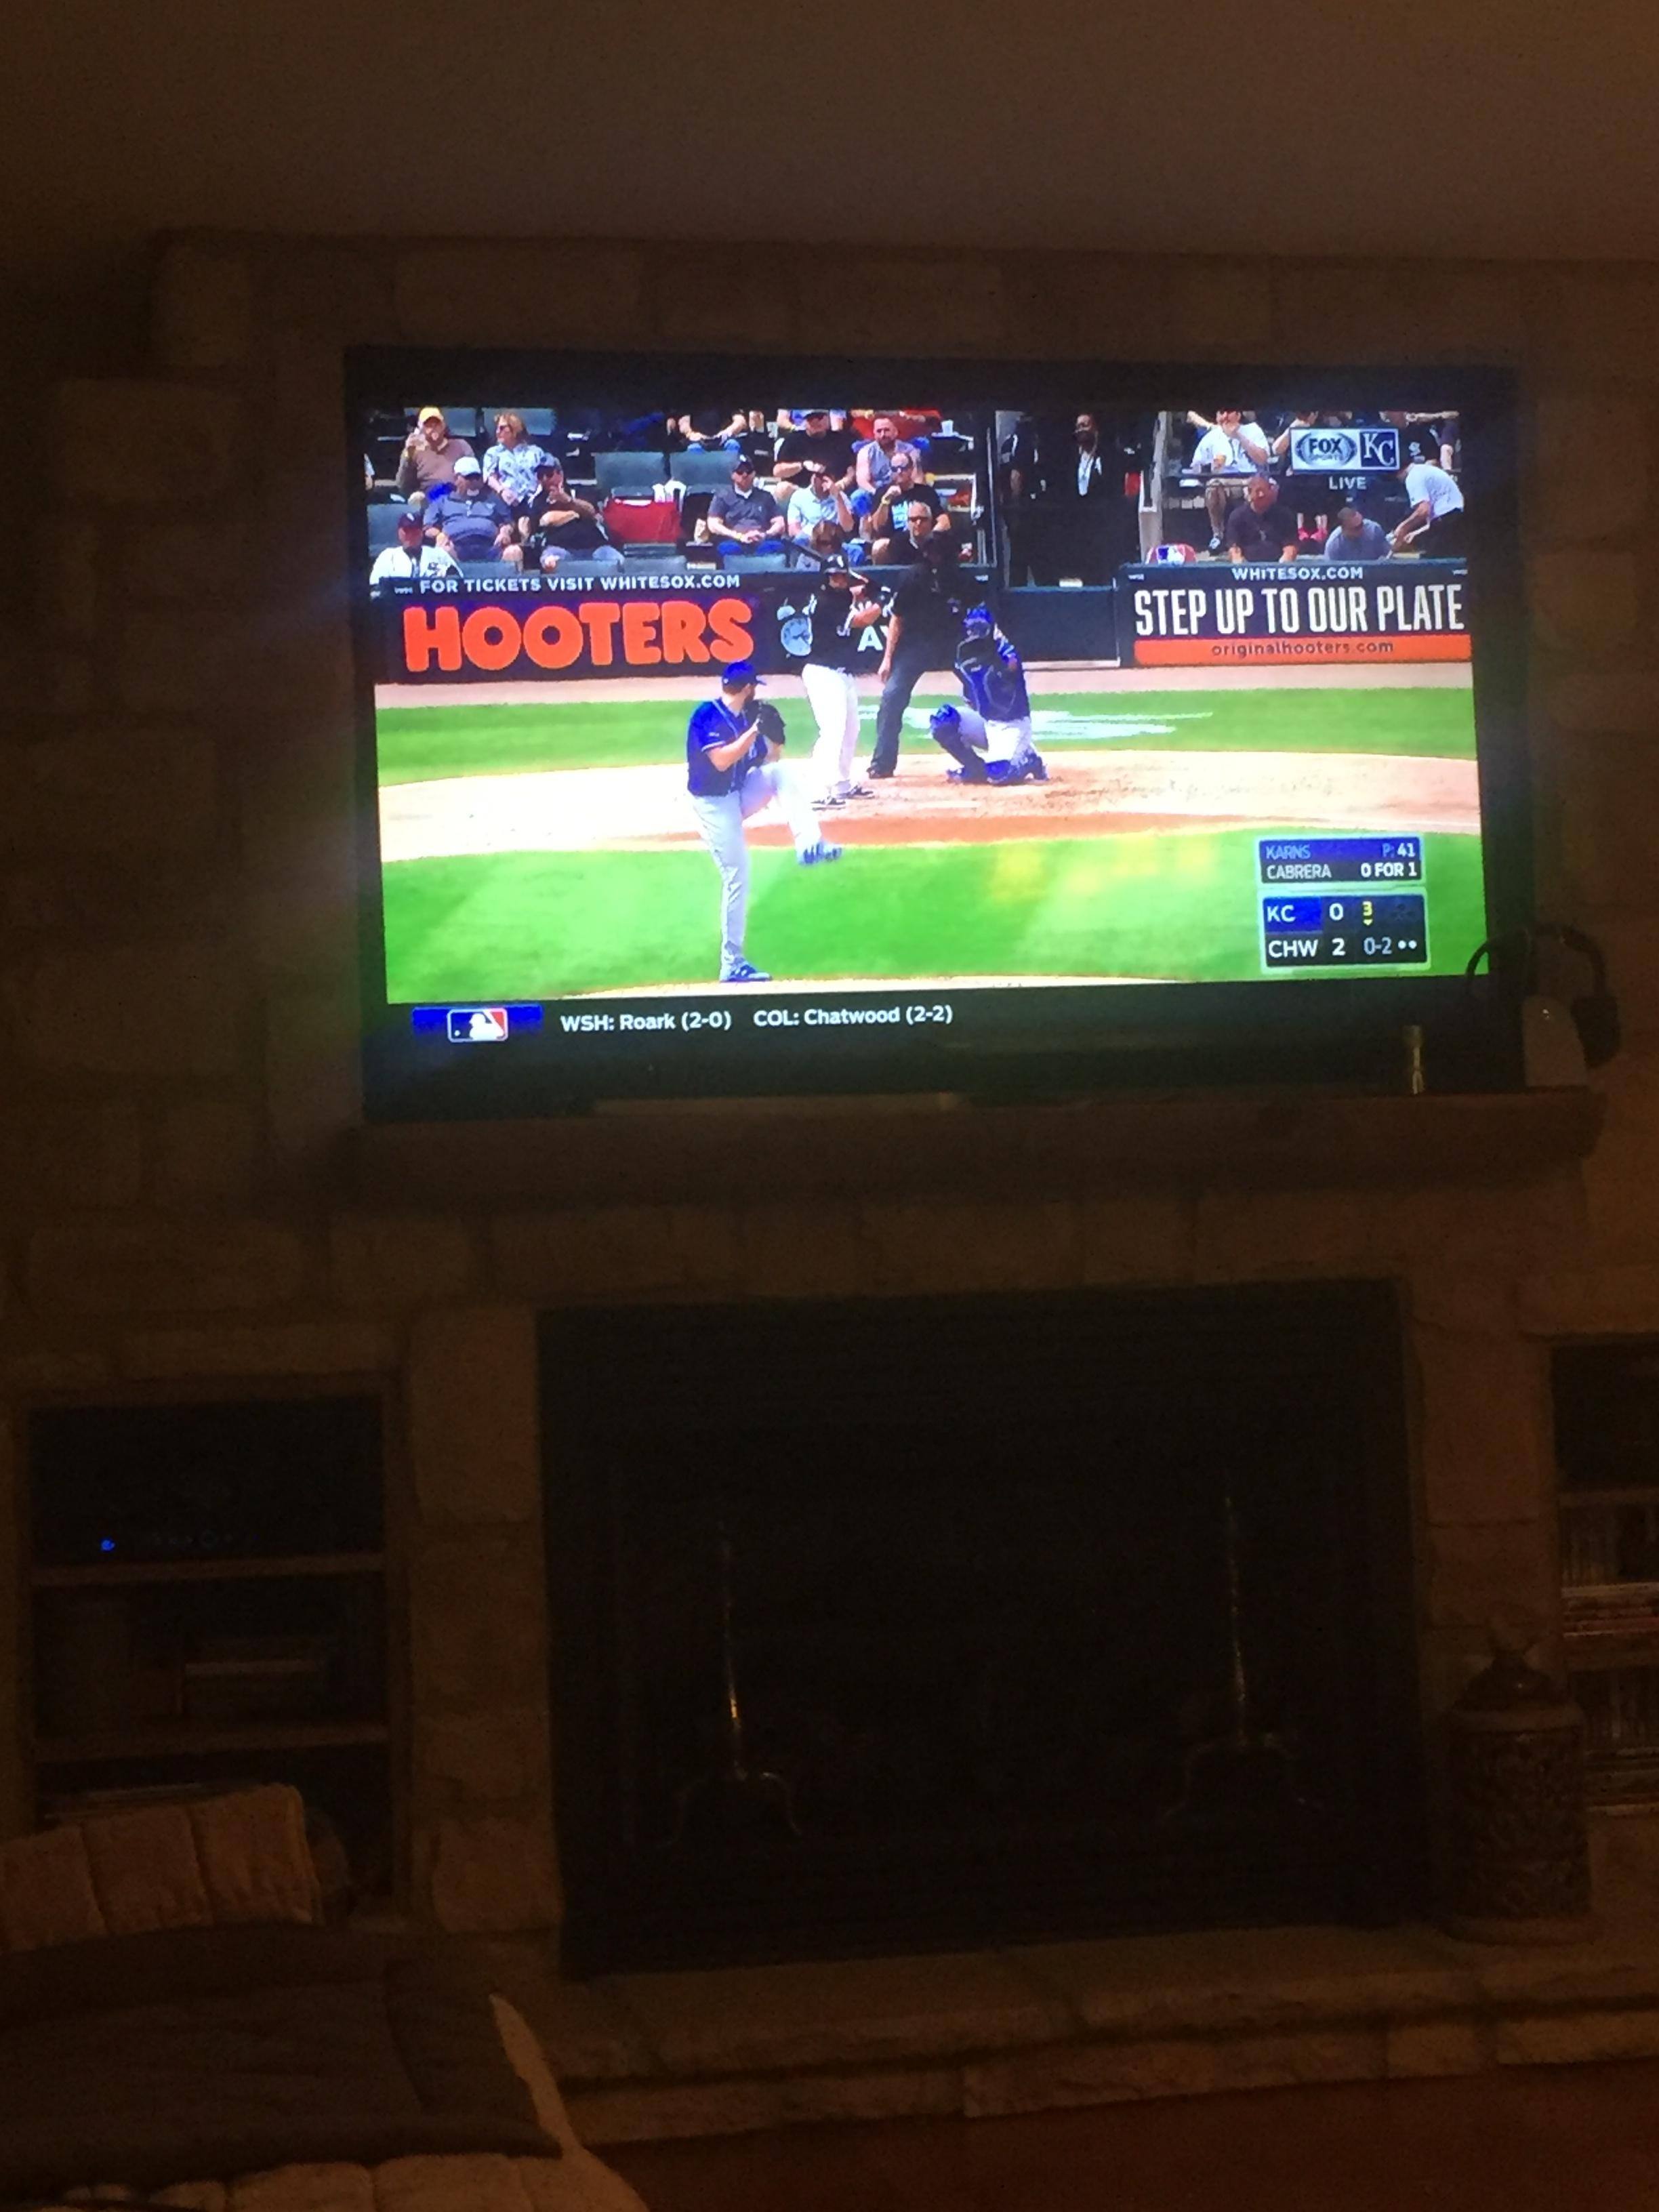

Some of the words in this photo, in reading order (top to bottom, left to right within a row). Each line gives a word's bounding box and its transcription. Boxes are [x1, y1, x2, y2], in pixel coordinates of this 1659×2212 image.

[1309, 438, 1343, 454] FOX
[1363, 433, 1394, 466] KC
[1328, 476, 1367, 490] LIVE
[419, 579, 458, 594] FOR
[464, 577, 541, 592] TICKETS
[547, 577, 594, 591] VISIT
[600, 574, 741, 591] WHITESOX.COM
[1231, 567, 1364, 581] WHITESOX.COM
[1134, 588, 1206, 636] STEP
[1215, 588, 1254, 634] UP
[1261, 588, 1298, 634] TO
[1307, 586, 1368, 633] OUR
[1376, 583, 1465, 632] PLATE
[403, 598, 754, 672] HOOTERS
[1265, 844, 1311, 860] KARNS
[1382, 844, 1394, 858] P:
[1397, 842, 1416, 857] 41
[1267, 863, 1332, 880] CABRERA
[1361, 863, 1371, 878] 0
[1374, 862, 1404, 877] FOR
[1408, 861, 1417, 876] 1
[1267, 905, 1296, 922] KC
[1329, 903, 1344, 920] 0
[1362, 901, 1373, 916] 3
[1268, 939, 1319, 958] CHW
[1332, 938, 1346, 956] 2
[1364, 937, 1392, 955] 0-2
[560, 1015, 615, 1032] WSH:
[619, 1012, 676, 1031] Roark
[681, 1010, 732, 1032] (2-0)
[754, 1010, 800, 1026] COL:
[804, 1007, 900, 1025] Chatwood
[905, 1005, 953, 1025] (2-2)
